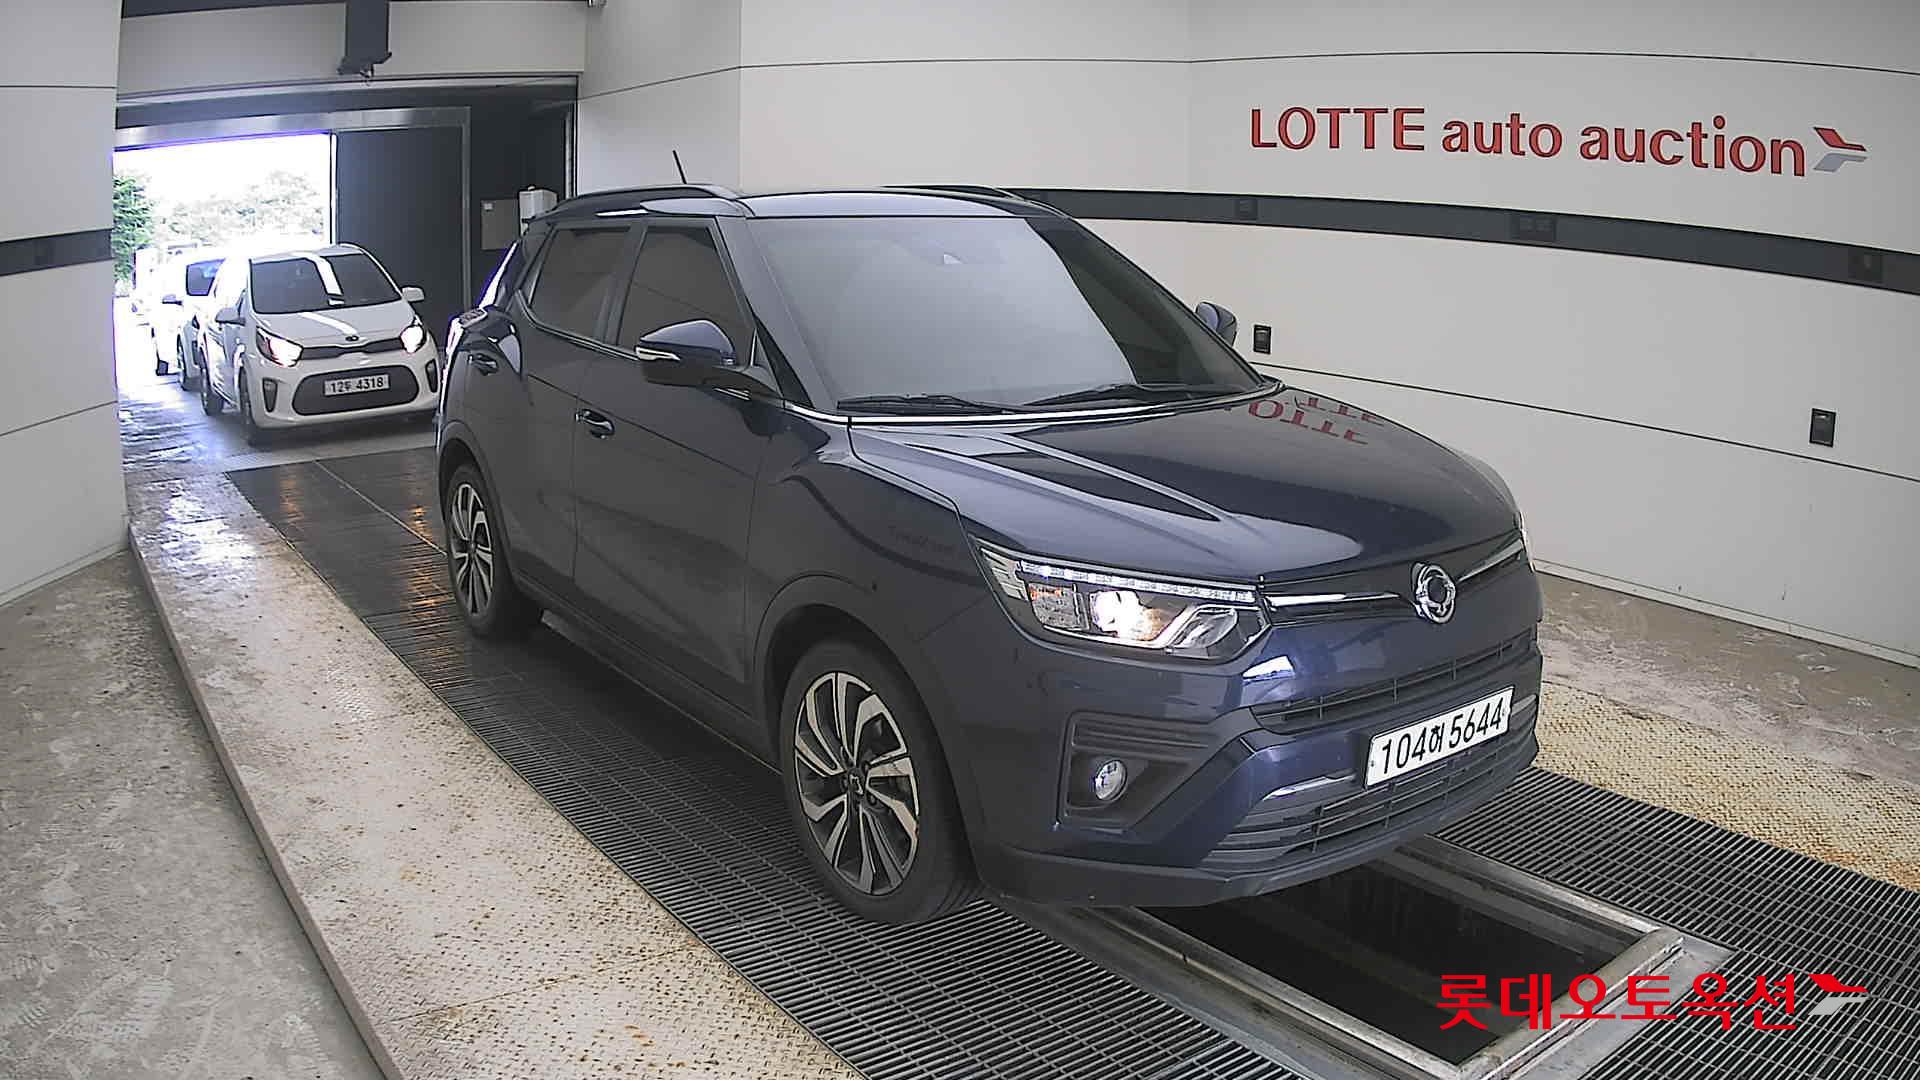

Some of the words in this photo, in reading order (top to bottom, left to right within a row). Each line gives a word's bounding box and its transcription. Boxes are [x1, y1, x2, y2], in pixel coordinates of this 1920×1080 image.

[1250, 106, 1426, 151] LOTTE
[1441, 112, 1562, 158] auto
[1579, 115, 1807, 177] auction
[356, 376, 384, 389] 4318
[1382, 722, 1446, 775] 104허
[1449, 697, 1504, 748] 5644
